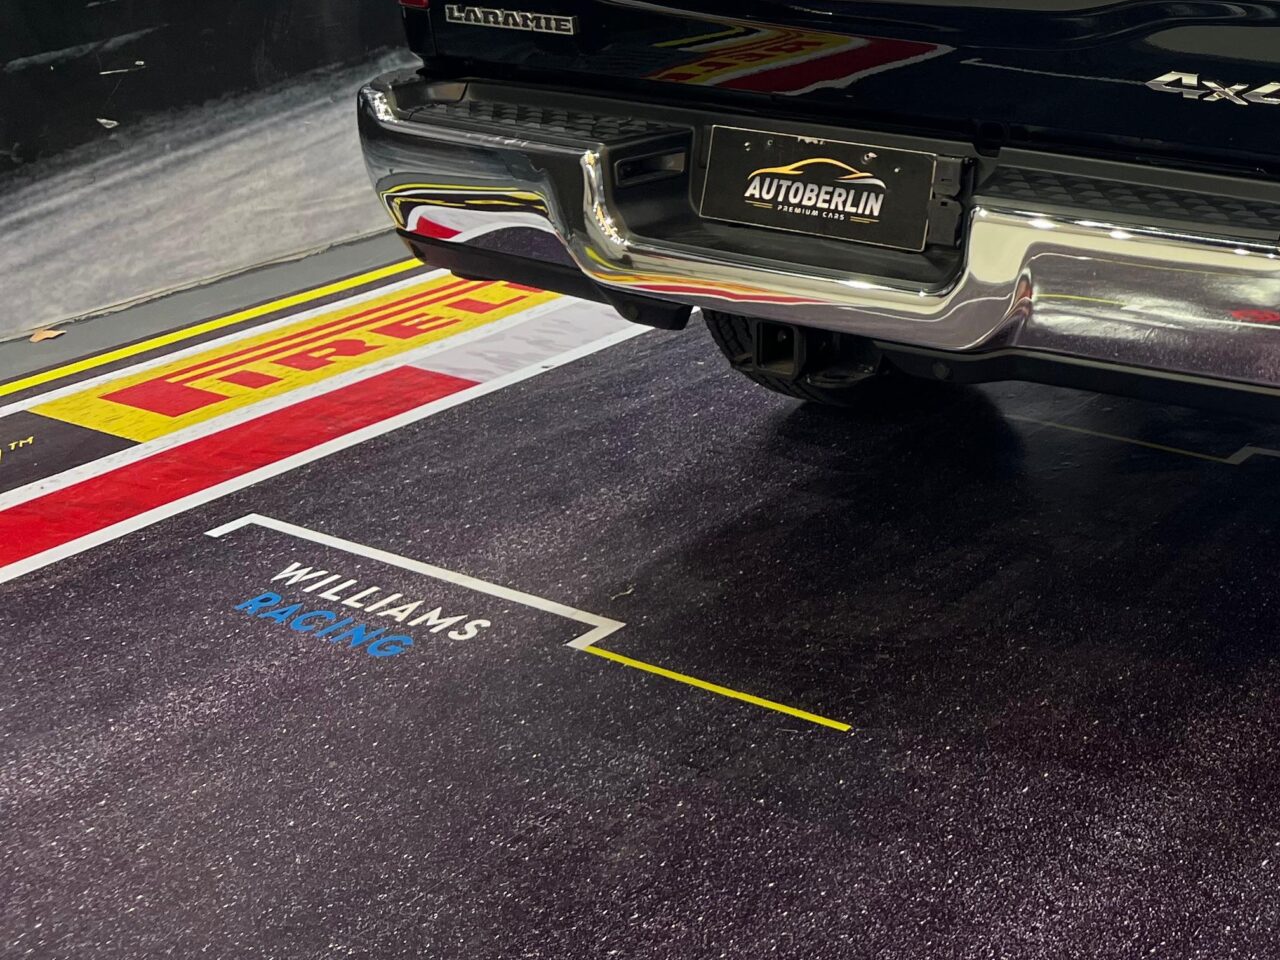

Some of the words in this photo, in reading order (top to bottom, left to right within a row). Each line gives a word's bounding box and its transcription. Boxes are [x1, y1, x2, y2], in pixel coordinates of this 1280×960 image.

[445, 4, 574, 36] LARAMIE
[744, 175, 885, 217] AUTOBERLIN
[777, 204, 819, 217] PREMIUM
[822, 211, 845, 221] CARS
[270, 561, 492, 641] WILLIAMS
[233, 591, 414, 658] RACING
